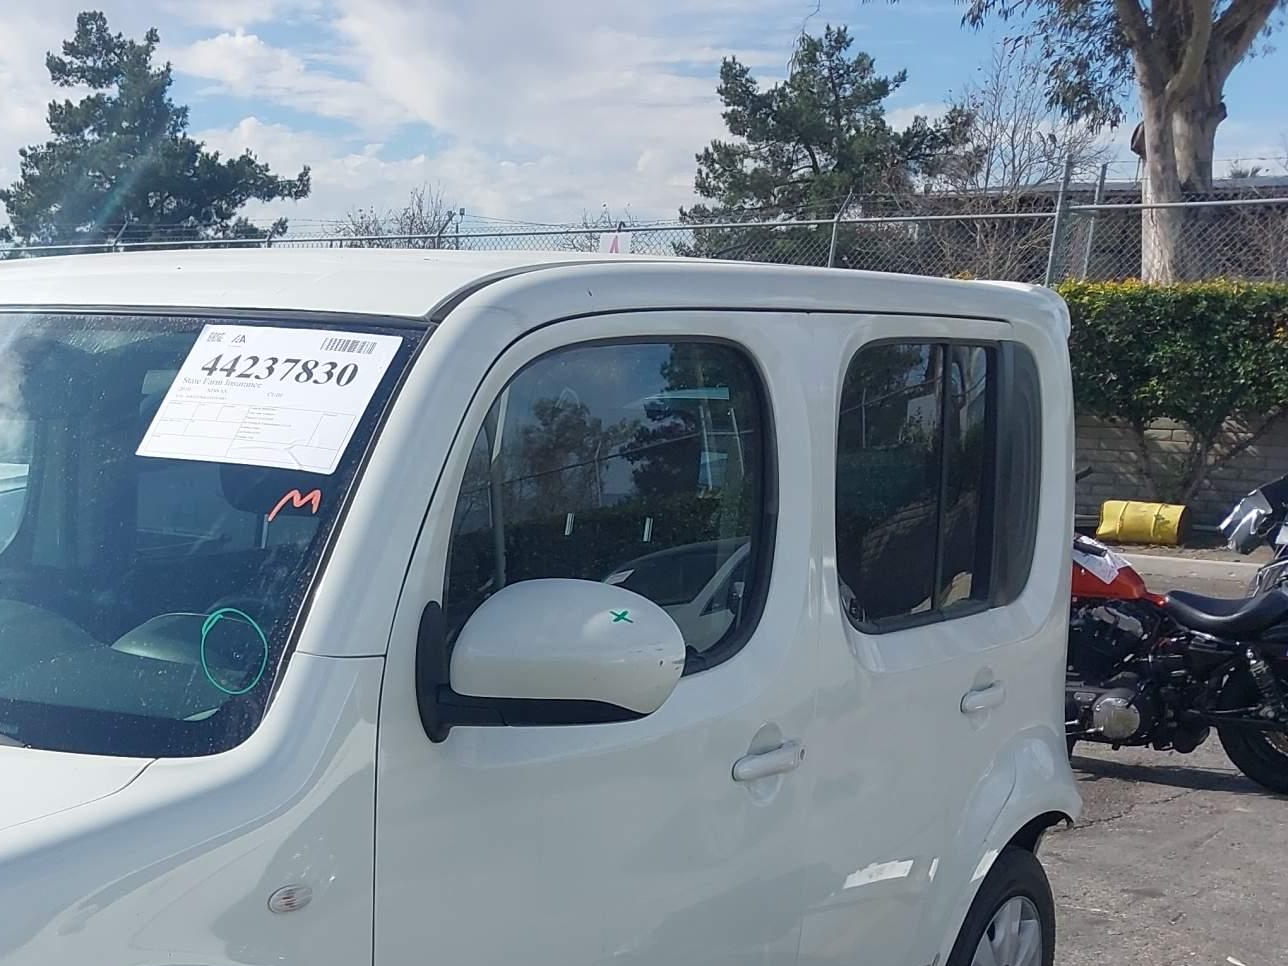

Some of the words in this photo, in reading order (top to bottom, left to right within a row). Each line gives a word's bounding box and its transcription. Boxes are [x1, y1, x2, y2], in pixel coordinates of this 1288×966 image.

[183, 376, 202, 385] State
[203, 377, 224, 386] Farm
[201, 353, 359, 388] 44237830
